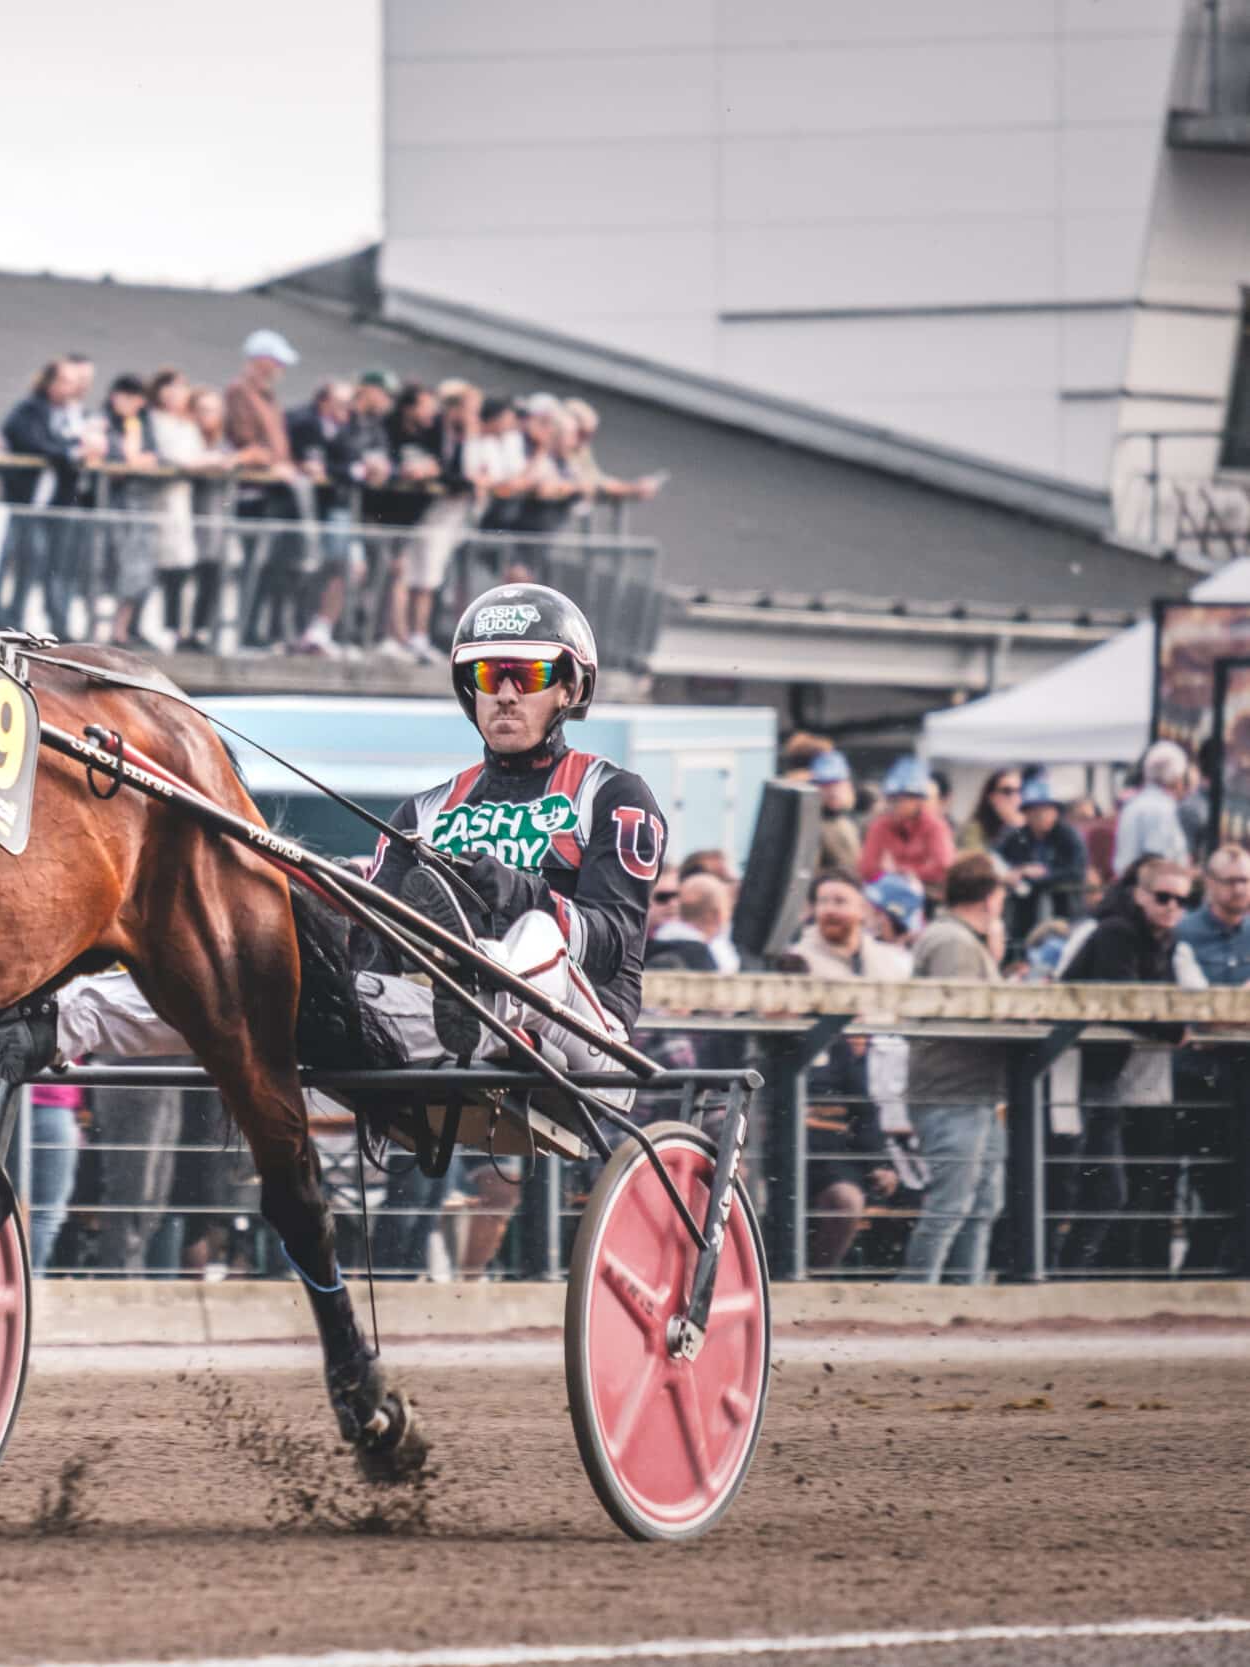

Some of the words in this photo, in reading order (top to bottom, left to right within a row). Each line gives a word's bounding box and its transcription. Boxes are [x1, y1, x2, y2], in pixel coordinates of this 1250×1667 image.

[478, 606, 517, 621] CASH
[476, 619, 527, 633] BUDDY
[612, 806, 663, 881] U
